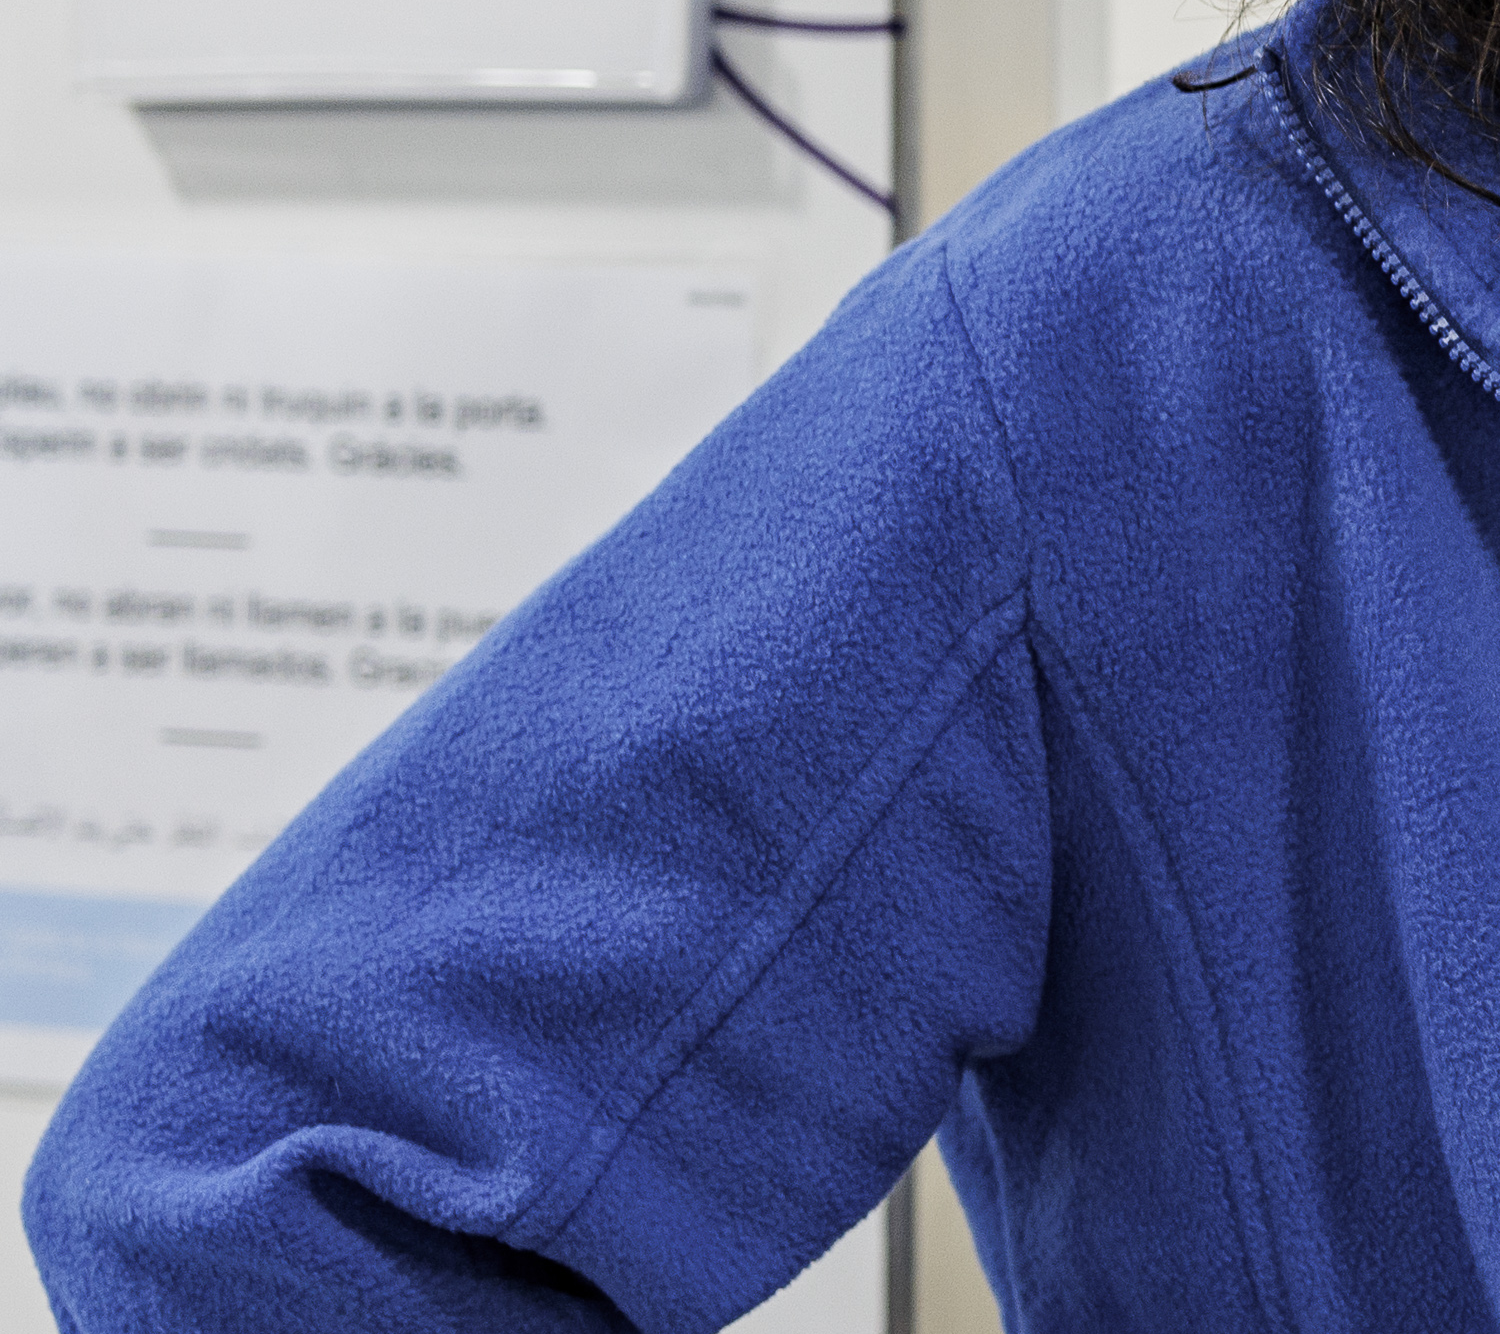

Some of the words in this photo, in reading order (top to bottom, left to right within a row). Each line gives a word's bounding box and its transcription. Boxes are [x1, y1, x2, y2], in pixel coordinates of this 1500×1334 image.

[78, 380, 120, 410] no
[126, 377, 210, 414] obrin
[220, 382, 249, 414] ni
[257, 382, 376, 425] truquin
[381, 391, 404, 424] a
[412, 385, 445, 426] la
[453, 389, 549, 432] porta.
[106, 432, 130, 463] a
[138, 433, 191, 465] ser
[327, 432, 466, 478] Gràcies.
[51, 586, 94, 620] no
[100, 585, 198, 624] abran
[205, 591, 237, 626] ni
[244, 590, 357, 632] llamen
[364, 602, 387, 636] a
[395, 598, 427, 638] la
[87, 642, 111, 674] a
[119, 645, 172, 676] ser
